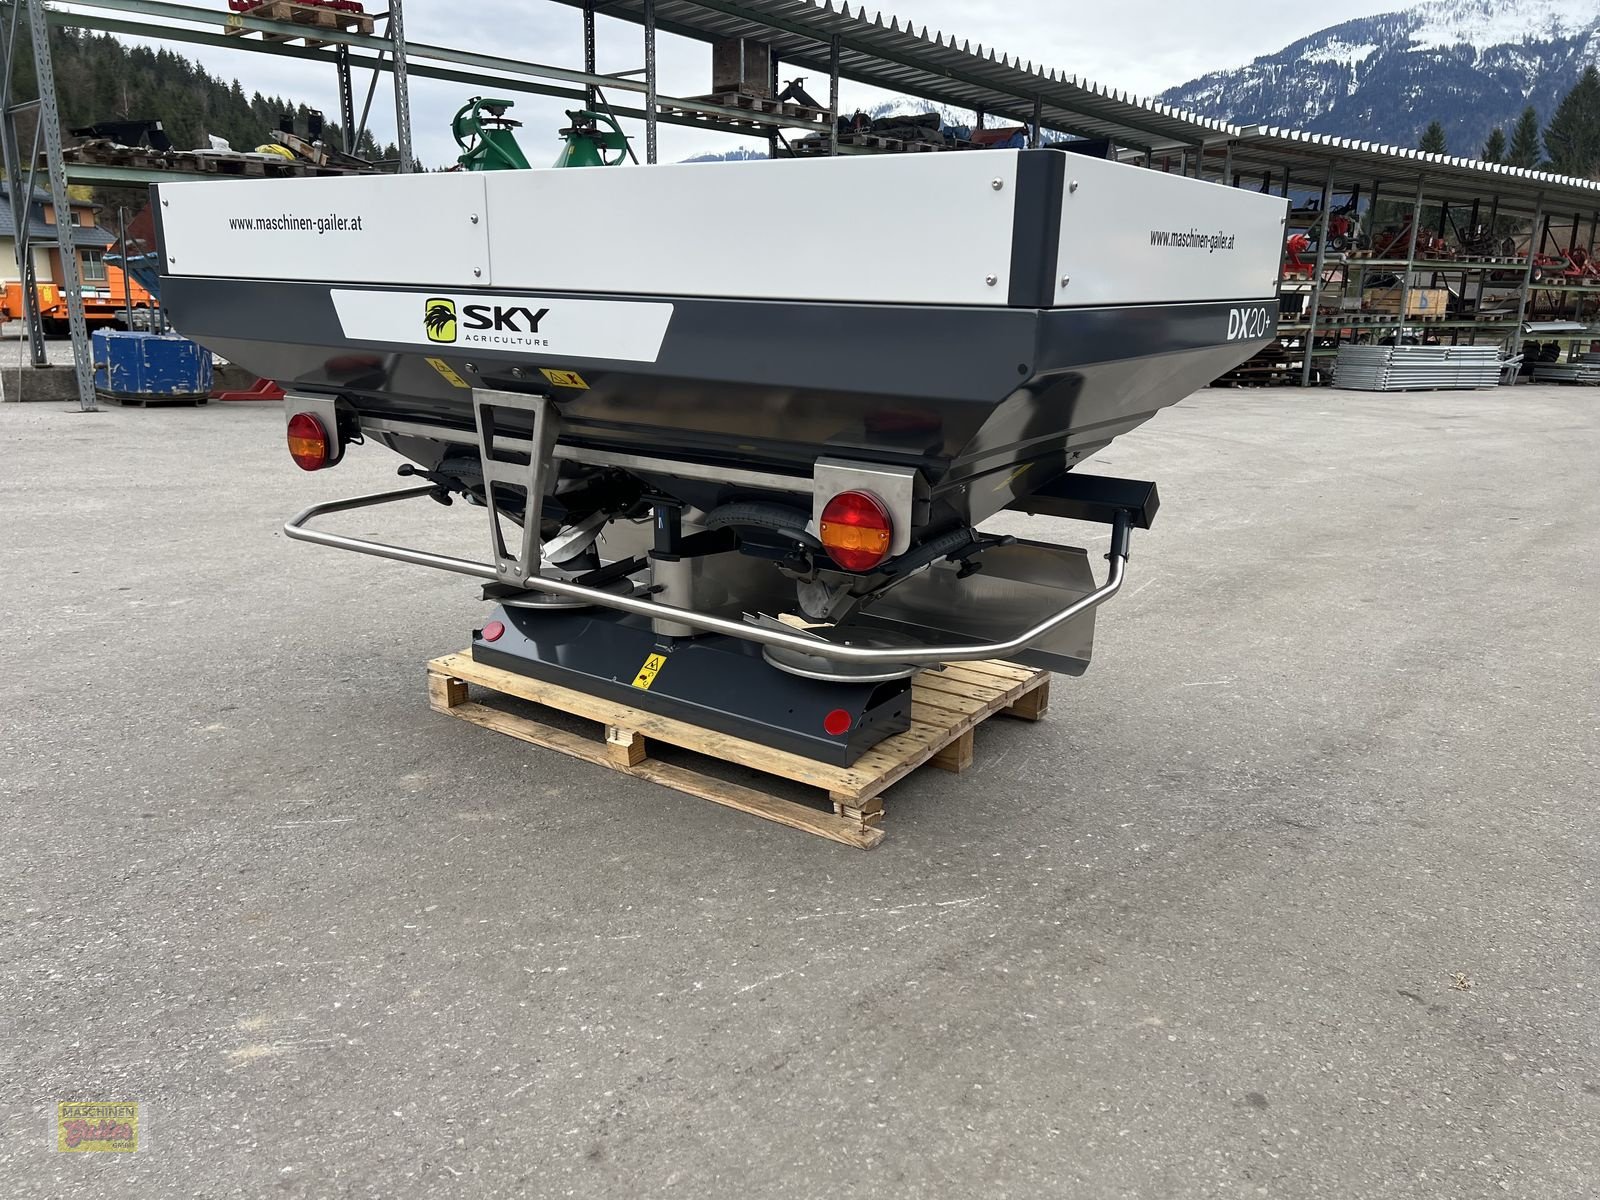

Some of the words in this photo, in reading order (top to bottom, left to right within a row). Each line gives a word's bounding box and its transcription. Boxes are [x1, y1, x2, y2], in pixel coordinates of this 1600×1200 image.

[229, 213, 362, 235] www.maschinen-gailer.at
[1150, 228, 1235, 253] www.maschinen-gailer.at
[462, 304, 550, 333] SKY
[1227, 307, 1271, 340] DX20+
[465, 334, 549, 346] AGRICULTURE
